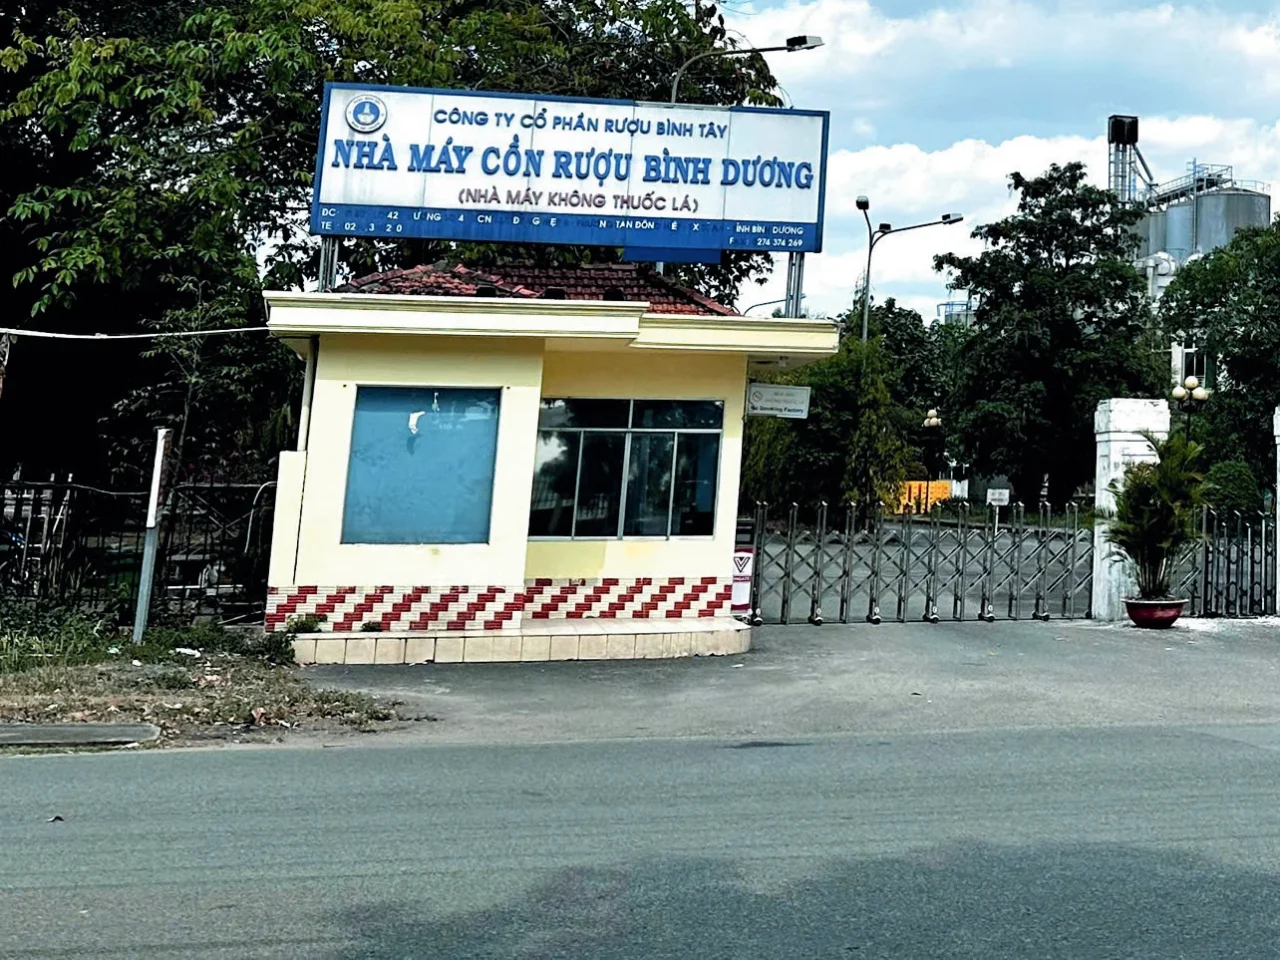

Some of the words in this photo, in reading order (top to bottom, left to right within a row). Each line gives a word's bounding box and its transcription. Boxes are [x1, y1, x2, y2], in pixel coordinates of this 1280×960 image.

[433, 107, 489, 126] CÔNG
[494, 112, 515, 128] TY
[520, 108, 547, 129] CỔ
[604, 117, 651, 137] RƯỢU
[656, 118, 693, 138] BÌNH
[698, 121, 728, 139] TÂY
[331, 133, 398, 171] NHÀ
[407, 136, 474, 174] MÁY
[481, 133, 545, 178] CỒN
[552, 147, 633, 188] RƯỢU
[643, 147, 712, 185] BÌNH
[720, 155, 814, 189] DƯƠNG
[458, 185, 501, 204] (NHÀ
[505, 187, 543, 206] MÁY
[547, 189, 606, 208] KHÔNG
[612, 190, 667, 211] THUỐC
[672, 194, 699, 214] LÁ)
